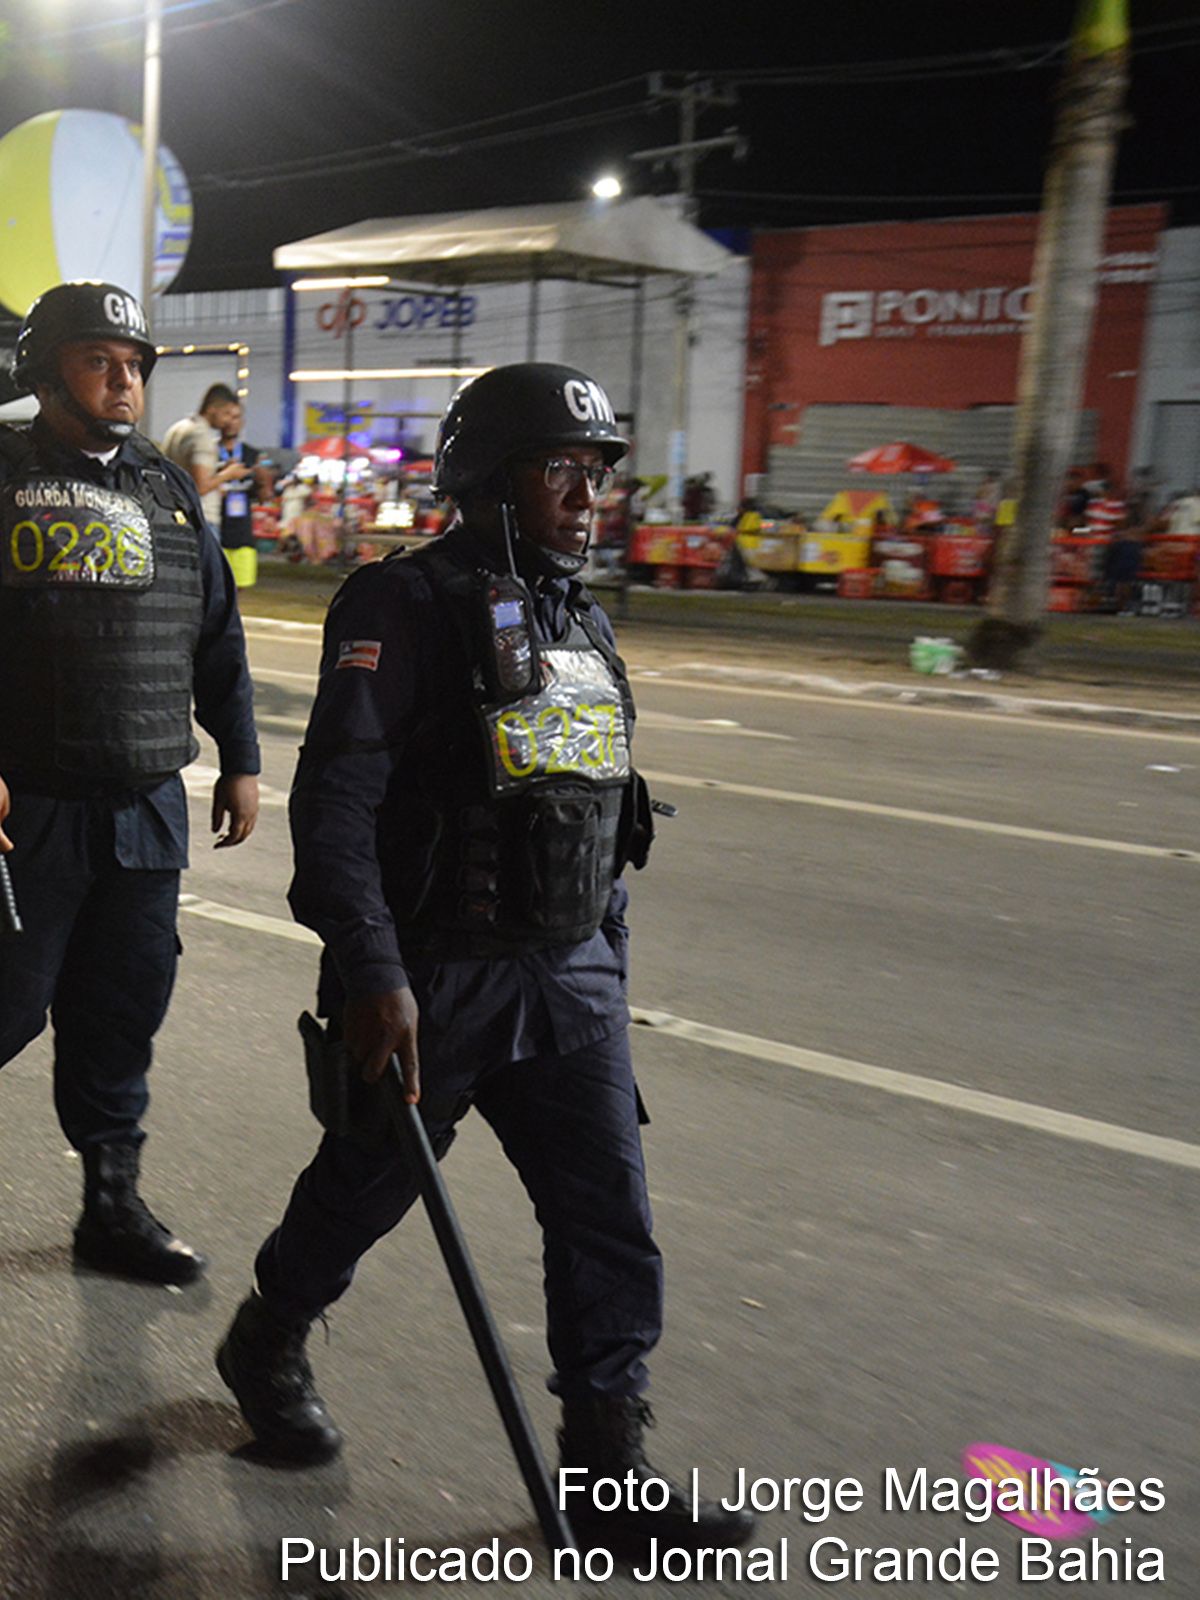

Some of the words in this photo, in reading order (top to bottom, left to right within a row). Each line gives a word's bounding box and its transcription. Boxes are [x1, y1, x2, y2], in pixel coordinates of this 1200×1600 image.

[103, 292, 146, 333] GM
[563, 379, 616, 425] GM
[15, 489, 72, 507] GUARDA
[10, 519, 147, 577] 0236
[497, 702, 617, 777] 0237
